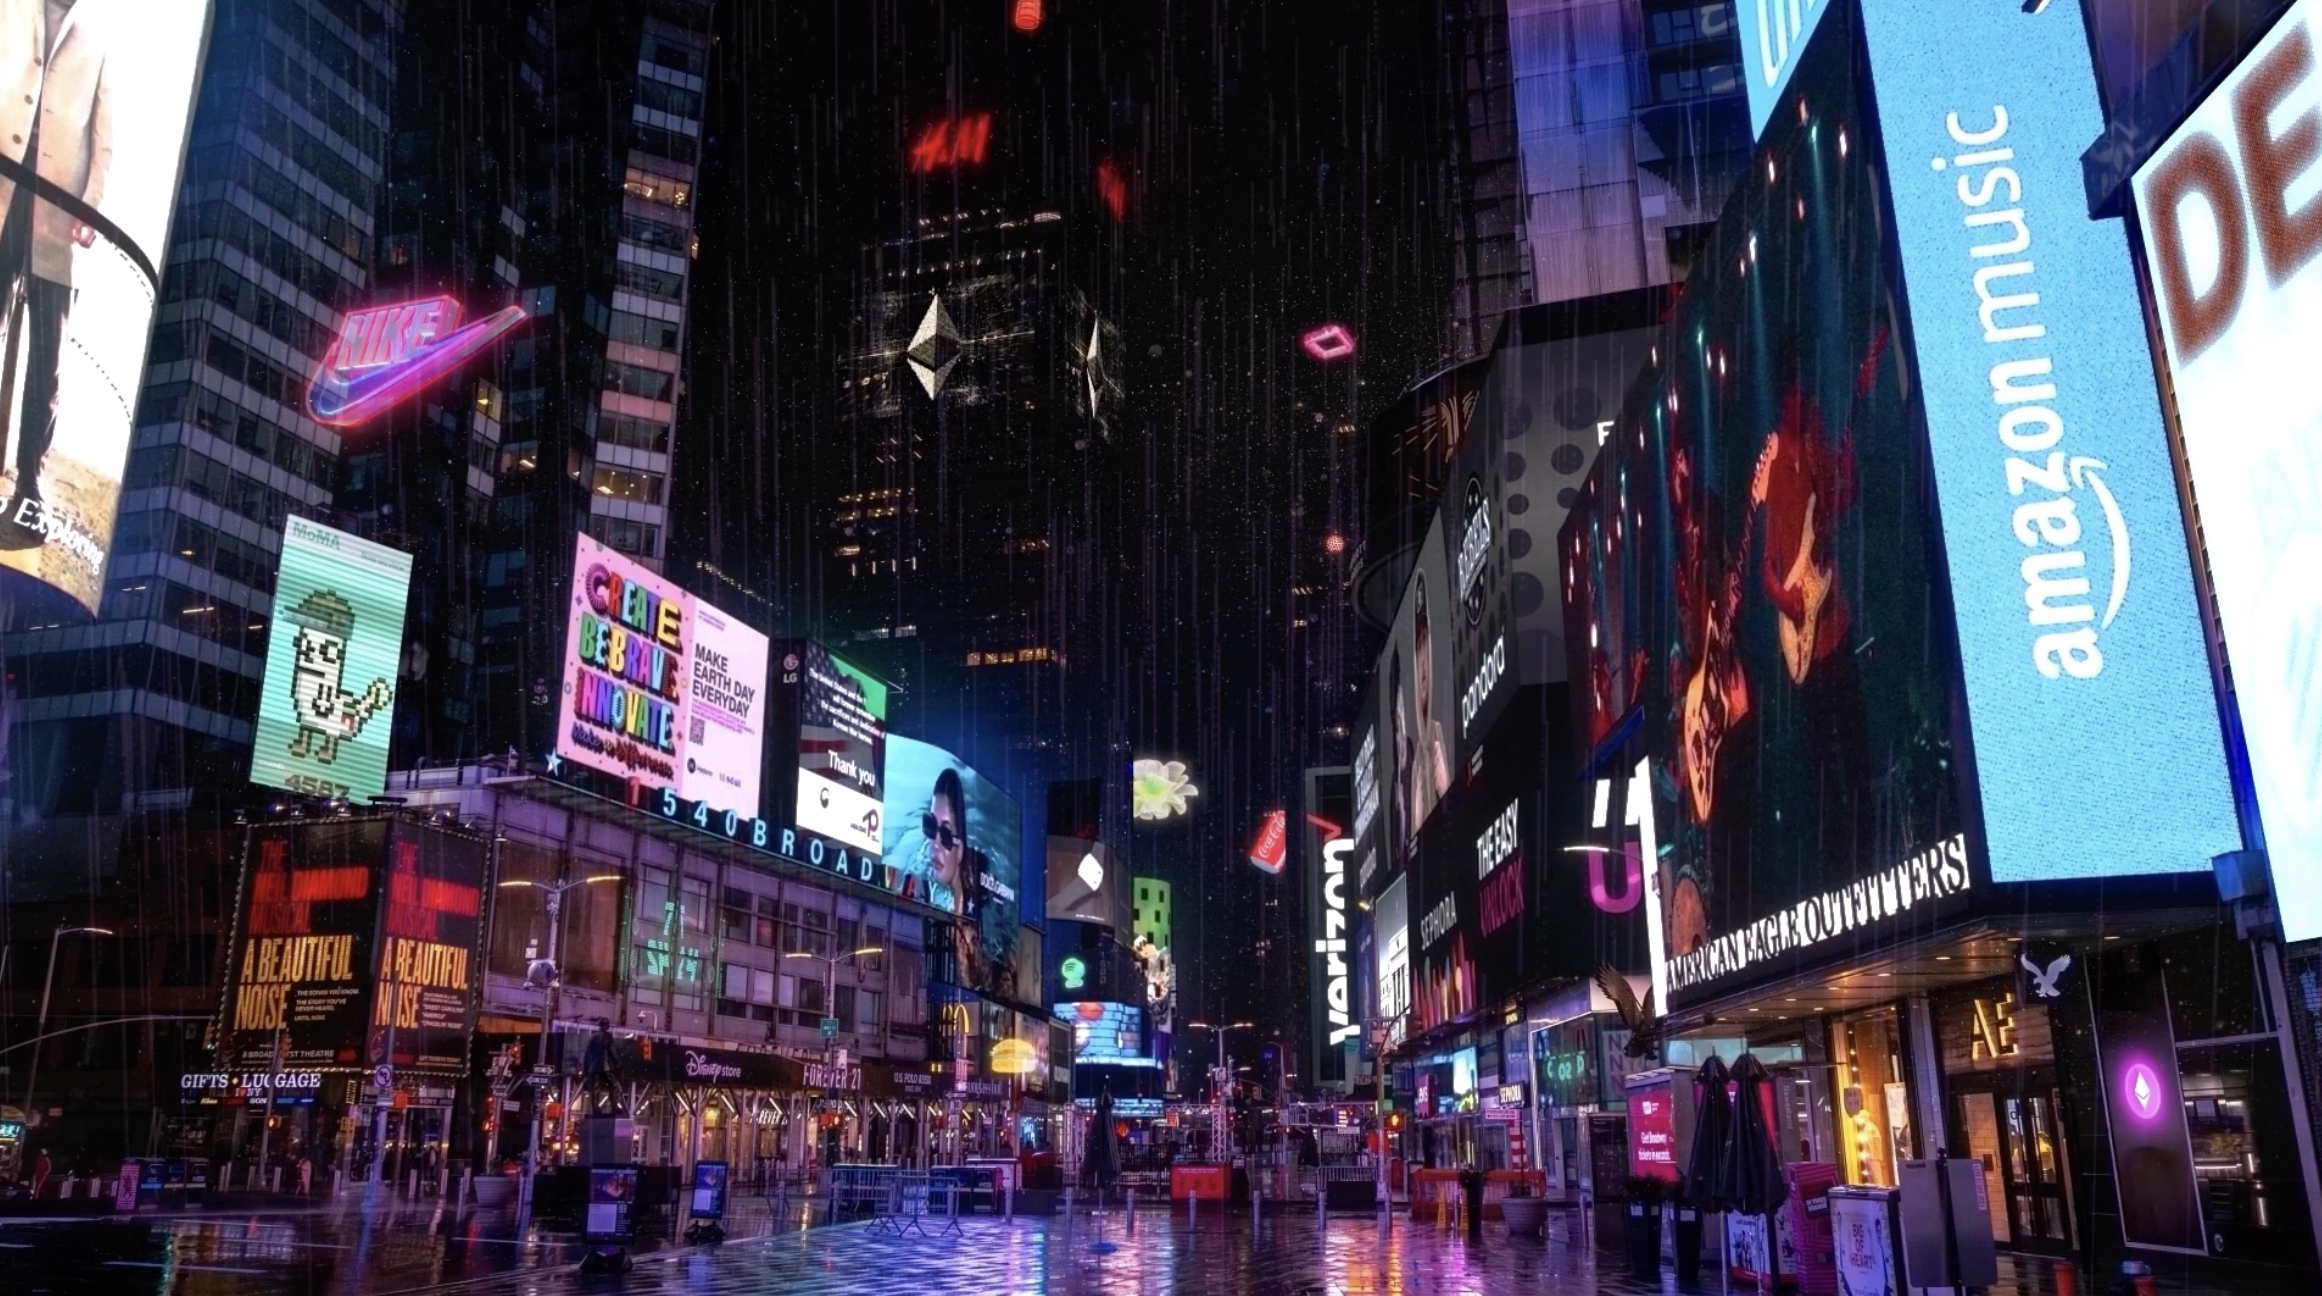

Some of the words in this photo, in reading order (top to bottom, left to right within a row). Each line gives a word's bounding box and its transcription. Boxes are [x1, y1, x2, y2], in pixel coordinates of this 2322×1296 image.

[1930, 104, 2046, 343] music
[335, 300, 442, 370] NIKE
[13, 497, 104, 575] Exploring
[292, 522, 341, 550] MoMA
[1989, 357, 2104, 681] amazon
[585, 562, 684, 655] CREATE
[695, 643, 728, 673] MAKE
[783, 674, 798, 684] LG
[692, 679, 750, 718] EVERYDAY
[693, 661, 731, 693] EARTH
[734, 680, 755, 703] DAY
[1461, 636, 1506, 739] pandora
[574, 667, 676, 757] INNOVATE
[828, 749, 857, 779] Thank
[858, 768, 875, 786] you
[1476, 826, 1495, 881] THE
[1495, 798, 1518, 867] EASY
[1420, 891, 1457, 950] SEPHORA
[1666, 929, 1739, 992] AMERICAN
[1745, 908, 1800, 964] EAGLE
[1803, 833, 1970, 944] OUTFITTERS
[240, 938, 255, 983] A
[257, 935, 353, 983] BEAUTIFUL
[381, 936, 393, 980] A
[395, 937, 468, 990] BEAUTIFUL
[1316, 838, 1361, 1046] verizon
[234, 983, 291, 1030] NOISE
[375, 982, 421, 1029] NISE
[1973, 993, 2018, 1060] AE
[301, 1049, 335, 1058] THEATRE
[721, 1064, 742, 1078] store
[181, 1074, 229, 1088] GIFTS
[851, 1068, 861, 1091] 21
[967, 1078, 990, 1098] unglass
[1500, 1084, 1522, 1103] SEPHORA
[1641, 1131, 1649, 1144] Get
[1852, 1223, 1863, 1238] BIG
